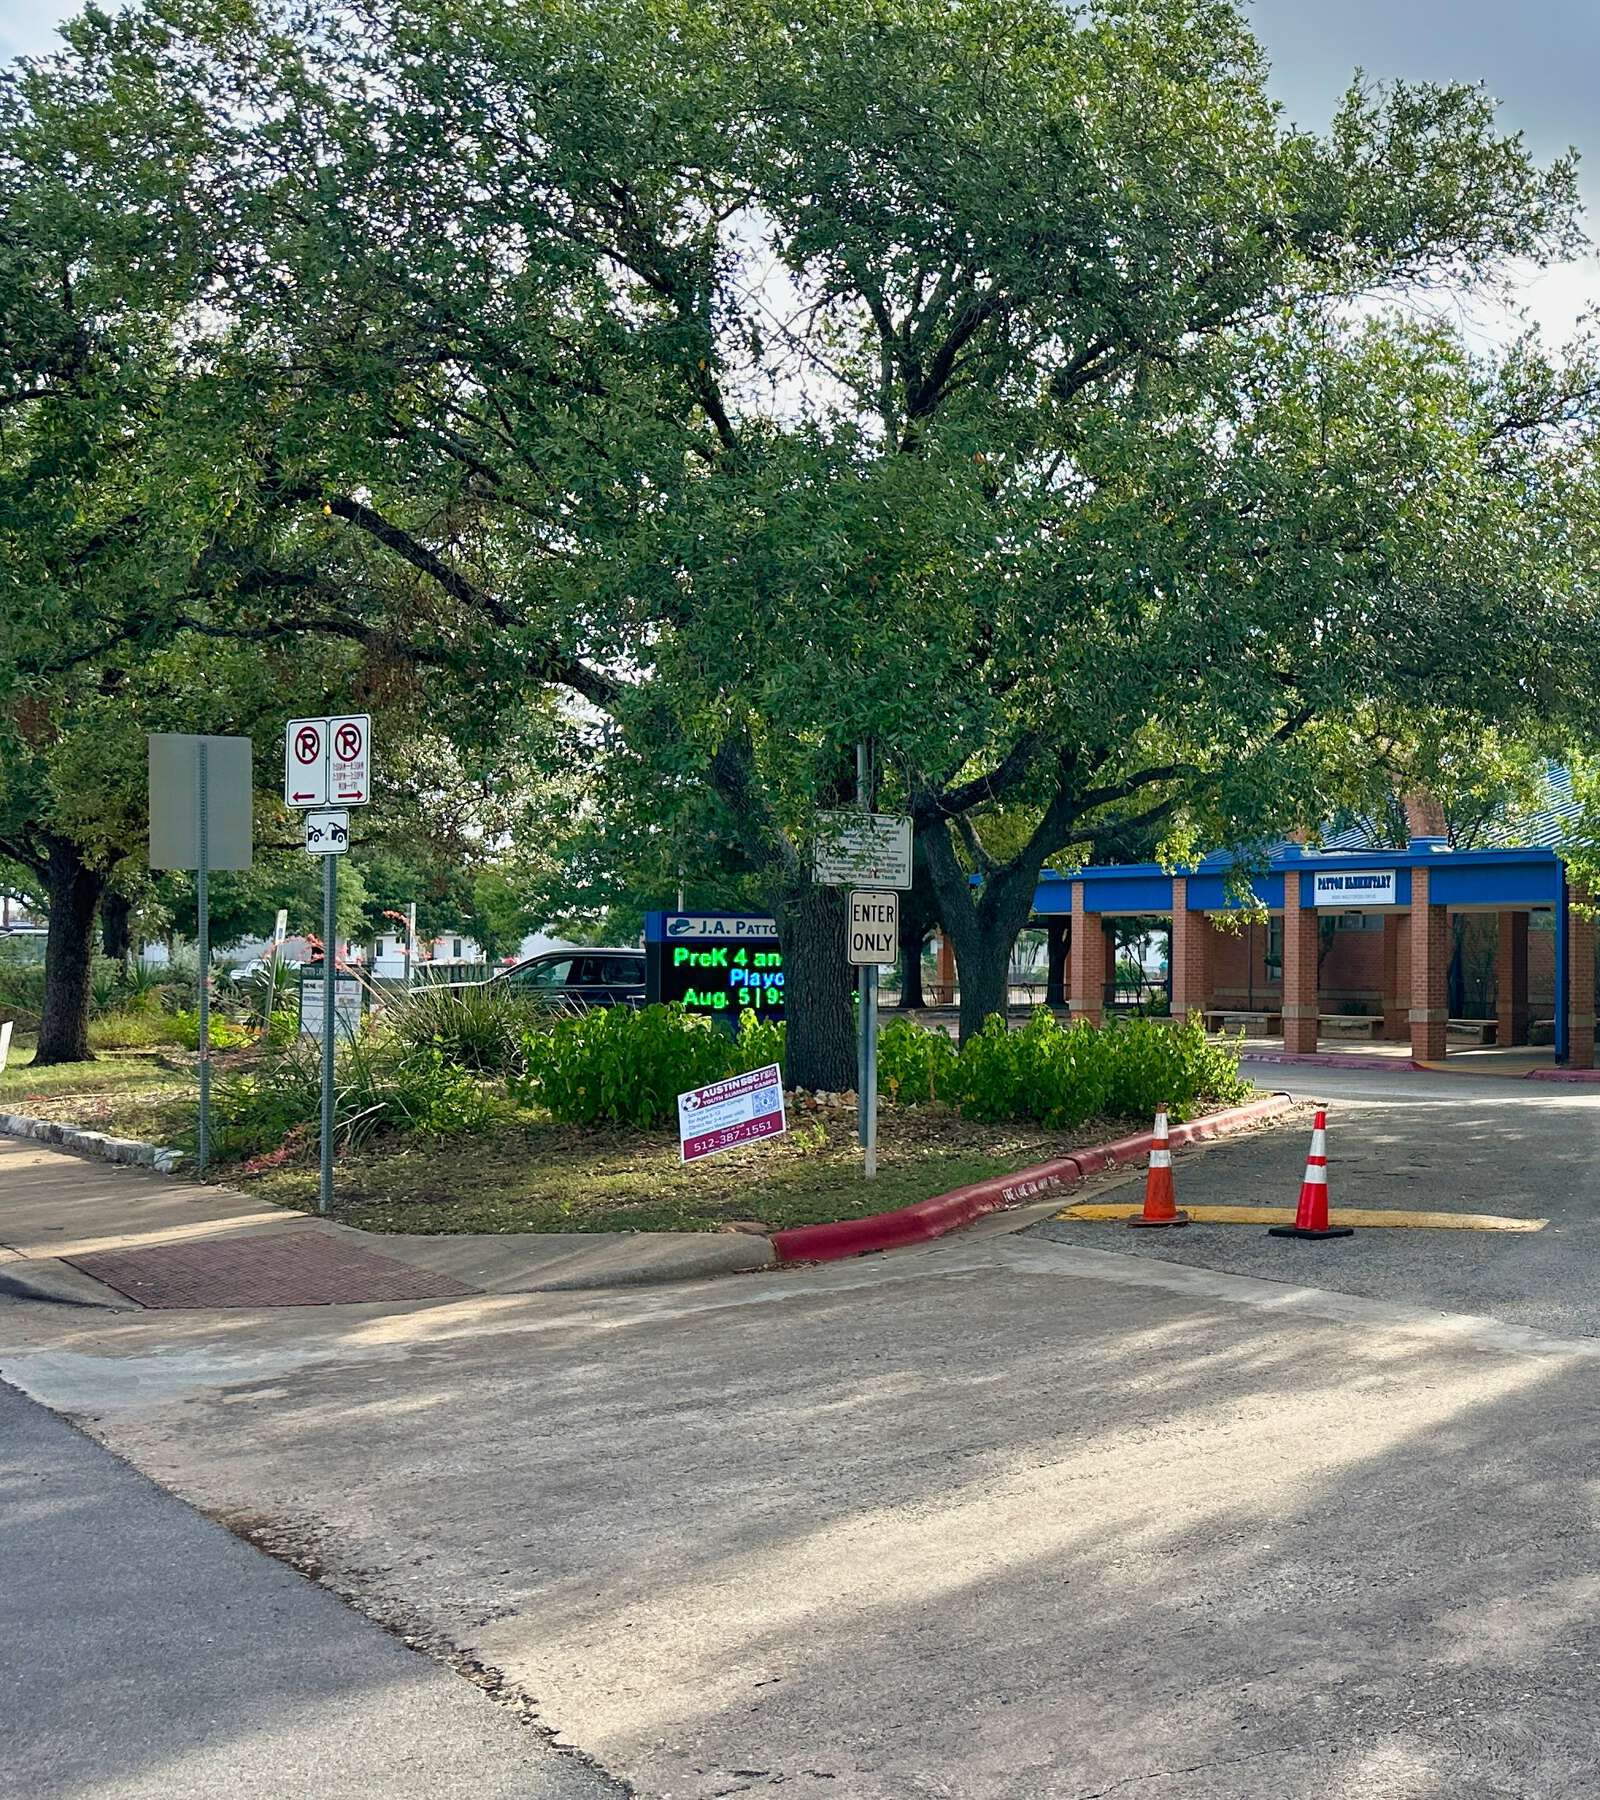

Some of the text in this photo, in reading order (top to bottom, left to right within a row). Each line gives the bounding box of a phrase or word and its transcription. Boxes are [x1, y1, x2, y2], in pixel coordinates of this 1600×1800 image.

[1317, 875, 1391, 890] PATTON ELEMENTARY
[853, 904, 894, 923] ENTER
[699, 920, 778, 935] J.A. PATTO
[853, 933, 893, 952] ONLY
[673, 947, 783, 967] PreK 4 an
[683, 988, 730, 1009] Aug.
[738, 988, 750, 1005] 5
[766, 988, 784, 1005] 9:
[702, 1079, 740, 1099] AUSTIN
[702, 1077, 776, 1106] YOUTH SUMMER CAMPS
[694, 1121, 771, 1152] 512-387-1551
